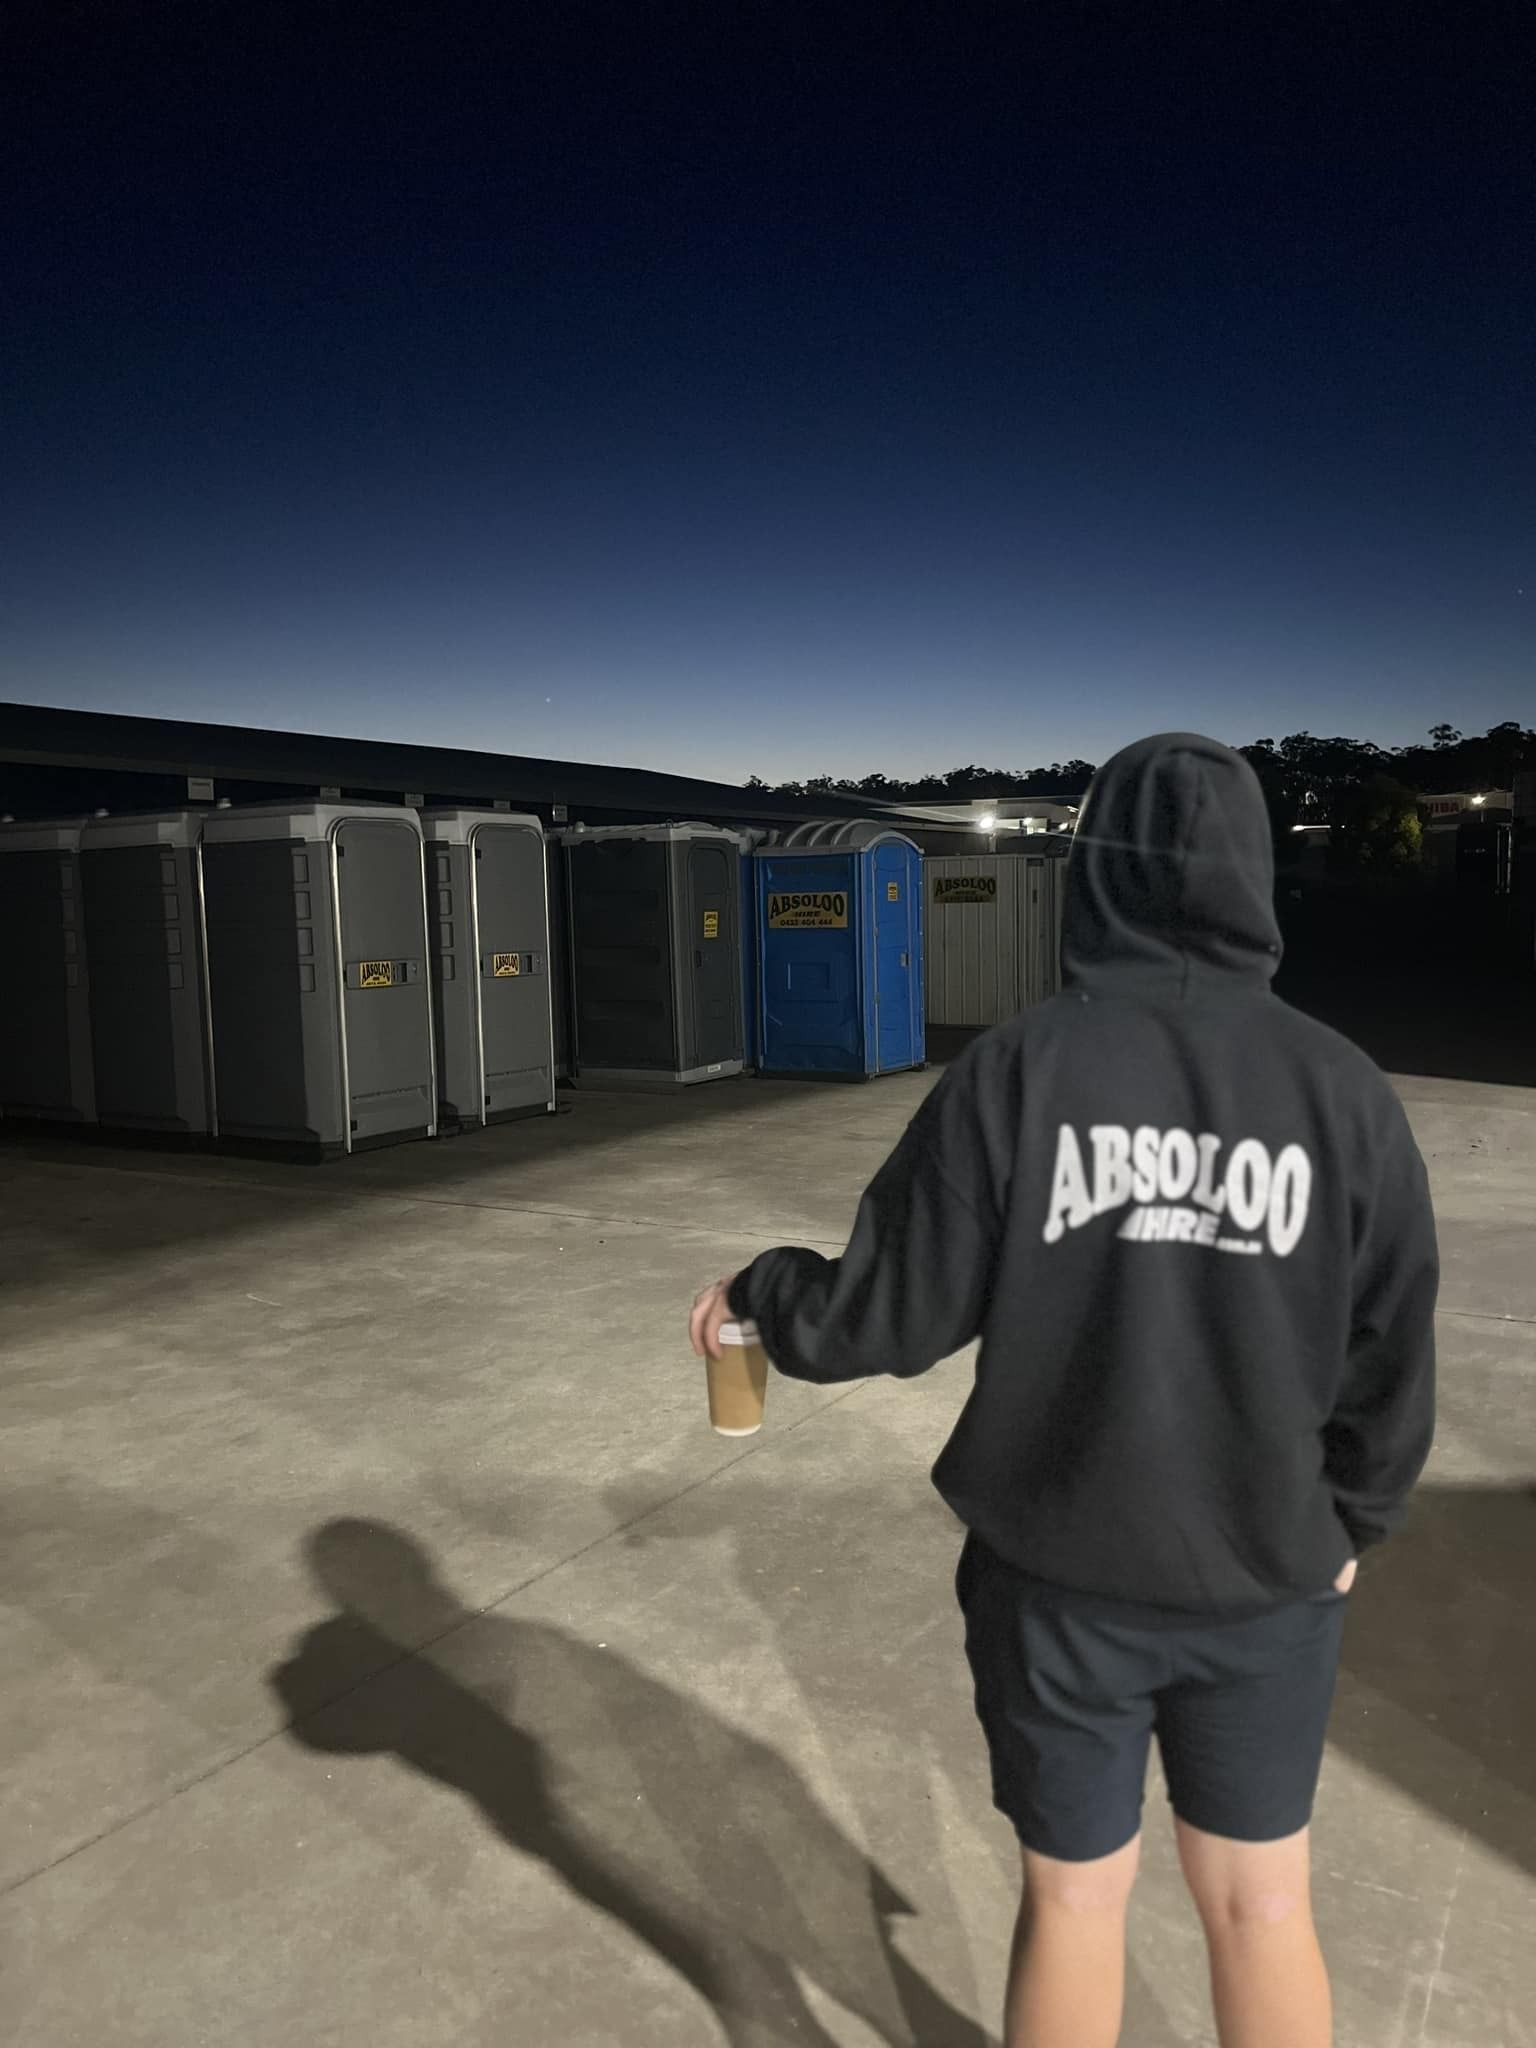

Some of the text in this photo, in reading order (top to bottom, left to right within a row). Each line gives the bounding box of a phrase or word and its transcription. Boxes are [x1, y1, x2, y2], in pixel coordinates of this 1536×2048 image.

[935, 877, 996, 896] ABSOLOO
[769, 894, 845, 920] ABSOLOO
[361, 962, 390, 985] ABSOLOO
[1043, 1123, 1312, 1257] ABSOLOO
